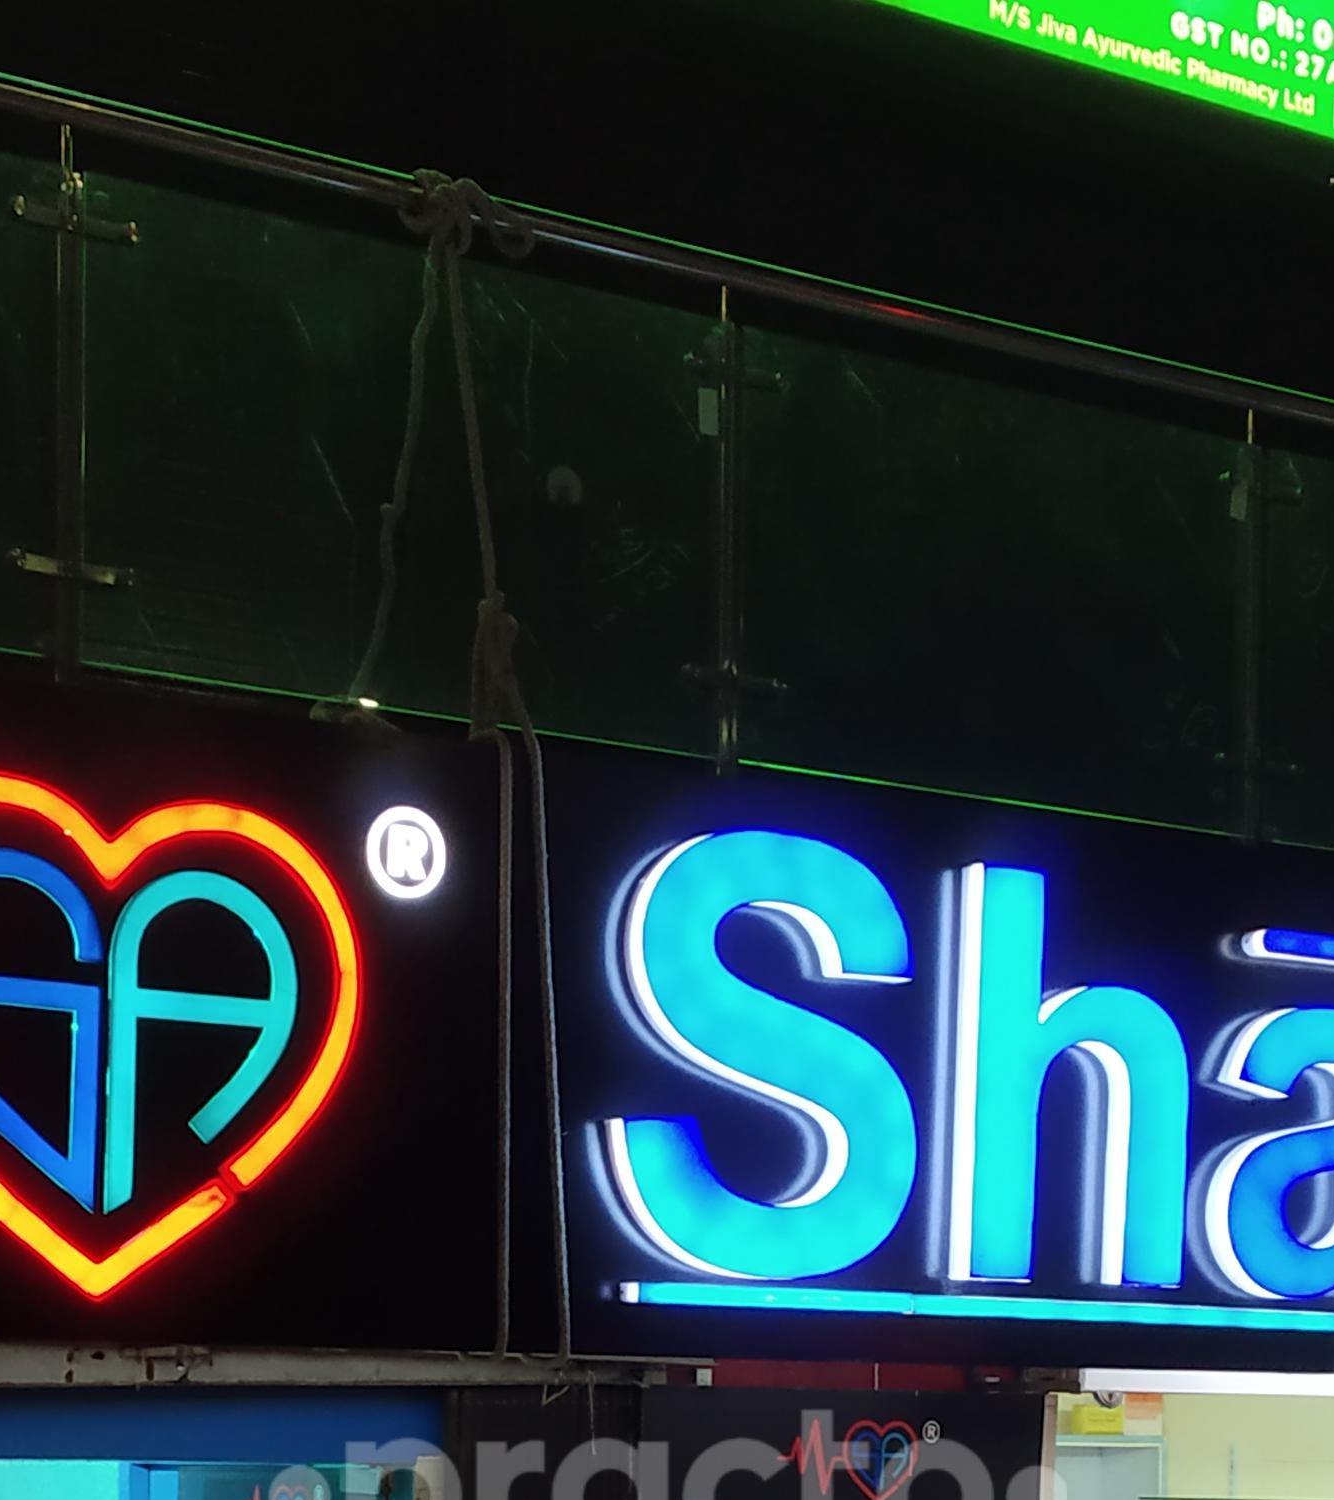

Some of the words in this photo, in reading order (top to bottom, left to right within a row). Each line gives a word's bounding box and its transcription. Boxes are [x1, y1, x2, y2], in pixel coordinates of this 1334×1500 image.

[1170, 11, 1224, 49] GST
[1257, 0, 1305, 43] Ph:
[989, 0, 1031, 30] M/S
[1036, 13, 1078, 46] Jiva
[1082, 26, 1182, 75] Ayurvedic
[1186, 57, 1279, 109] Pharmacy
[1283, 87, 1315, 117] Ltd
